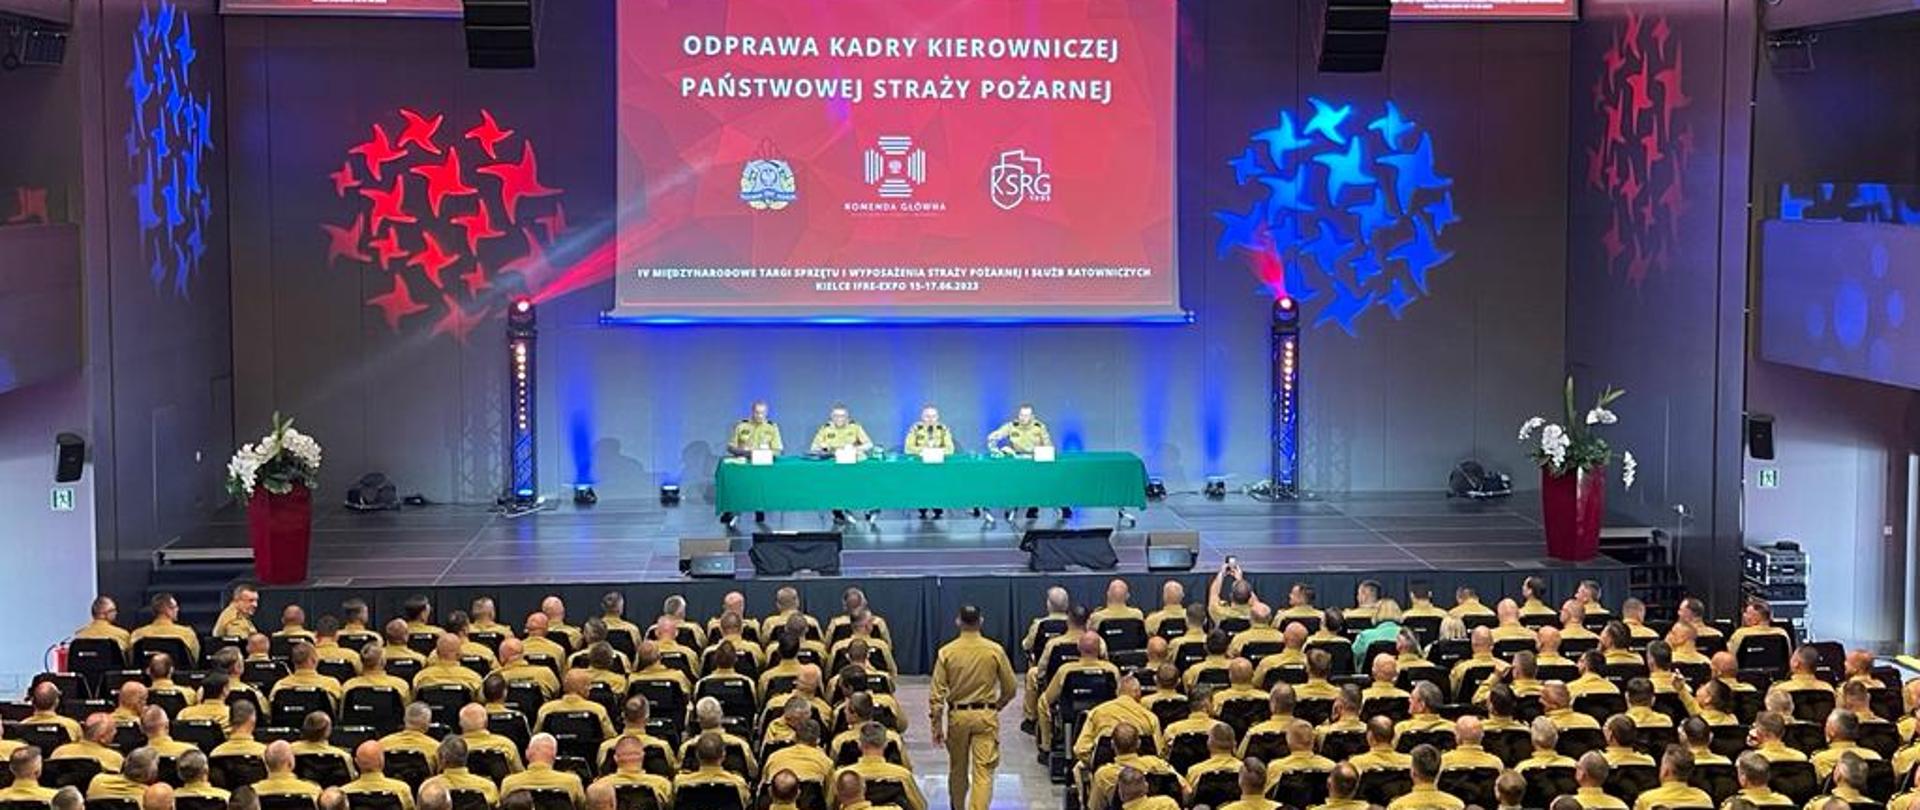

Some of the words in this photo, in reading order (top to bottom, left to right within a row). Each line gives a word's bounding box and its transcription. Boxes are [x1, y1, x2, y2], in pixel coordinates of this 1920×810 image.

[683, 35, 820, 56] ODPRAWA
[830, 37, 918, 58] KADRY
[927, 37, 1119, 63] KIEROWNICZEJ
[681, 72, 863, 103] PAŃSTWOWEJ
[873, 75, 971, 99] STRAŻY
[981, 75, 1112, 104] POŻARNEJ
[991, 173, 1051, 196] KSRG
[844, 202, 897, 212] KOMENDA
[637, 268, 650, 278] IV
[652, 268, 757, 280] MIĘDZYNARODOWE
[759, 268, 792, 278] TARGI
[794, 268, 840, 280] SPRZĘTU
[841, 268, 847, 278] I
[849, 267, 926, 278] WYPOSAŻENIA
[927, 267, 968, 278] STRAŻY
[969, 267, 1022, 279] POŻARNEJ
[1024, 268, 1029, 278] I
[1031, 267, 1065, 278] SŁUŻB
[1067, 268, 1152, 278] RATOWNICZYCH
[815, 282, 851, 291] KIELCE
[853, 282, 907, 291] IFRE-EXPO
[910, 282, 979, 291] 15-17.06.2023
